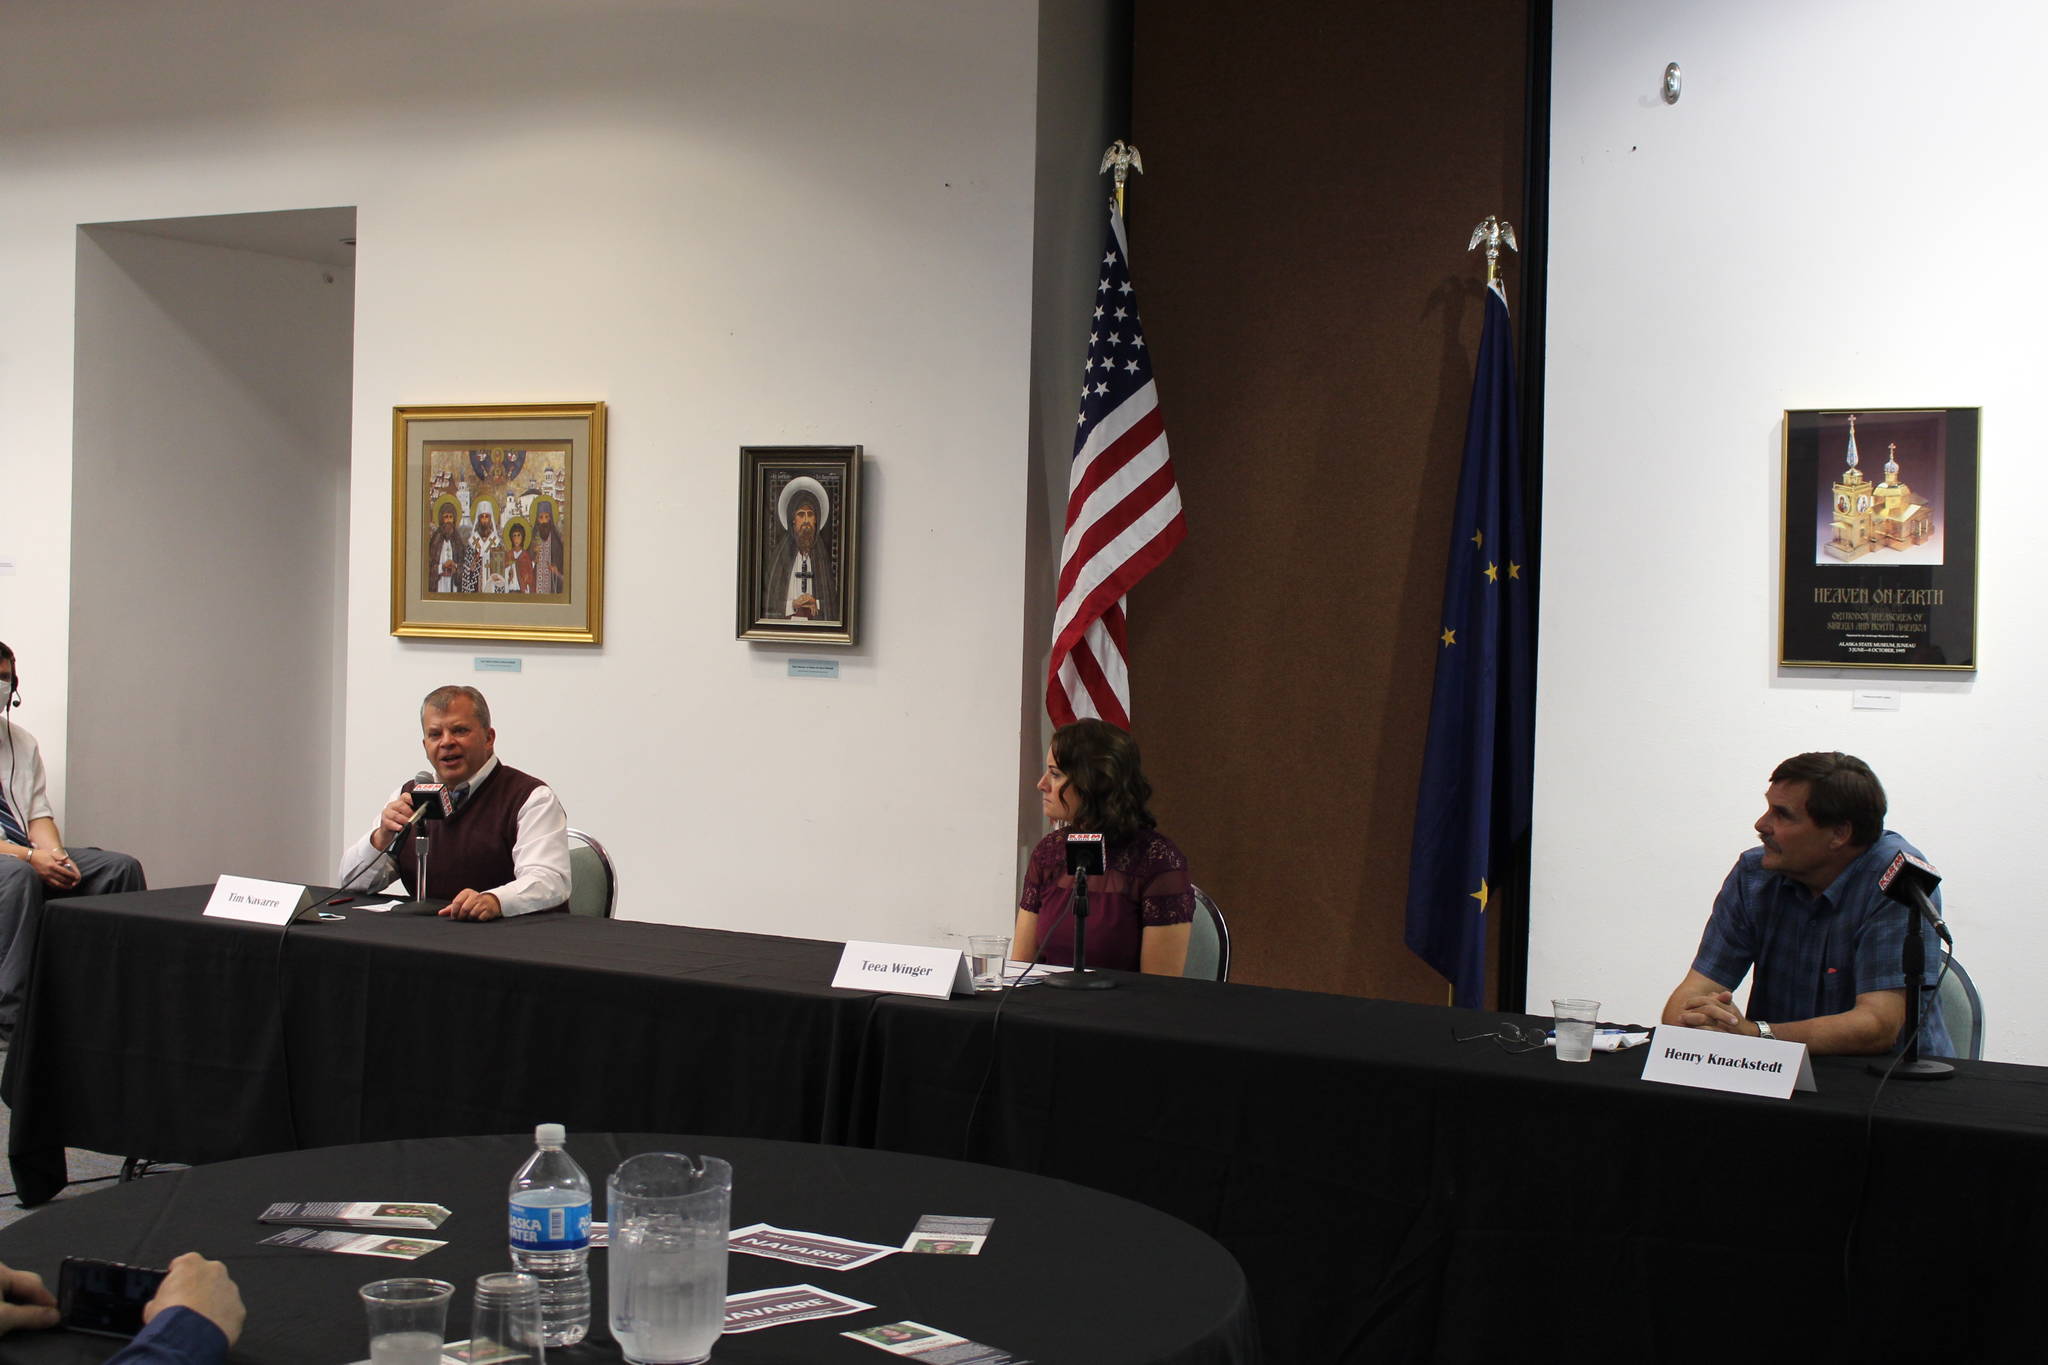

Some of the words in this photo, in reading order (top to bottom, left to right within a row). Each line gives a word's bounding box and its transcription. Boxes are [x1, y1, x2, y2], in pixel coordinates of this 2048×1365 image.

[1814, 588, 1869, 603] HEAVEN
[1872, 588, 1893, 604] ON
[1897, 589, 1944, 605] EARTH
[228, 892, 245, 903] Tim
[246, 895, 280, 908] Navarre
[861, 960, 888, 972] Teea
[891, 962, 933, 977] Winger
[1664, 1047, 1705, 1065] Henry
[1707, 1053, 1783, 1073] Knackstedt
[742, 1237, 857, 1261] NAVARRE
